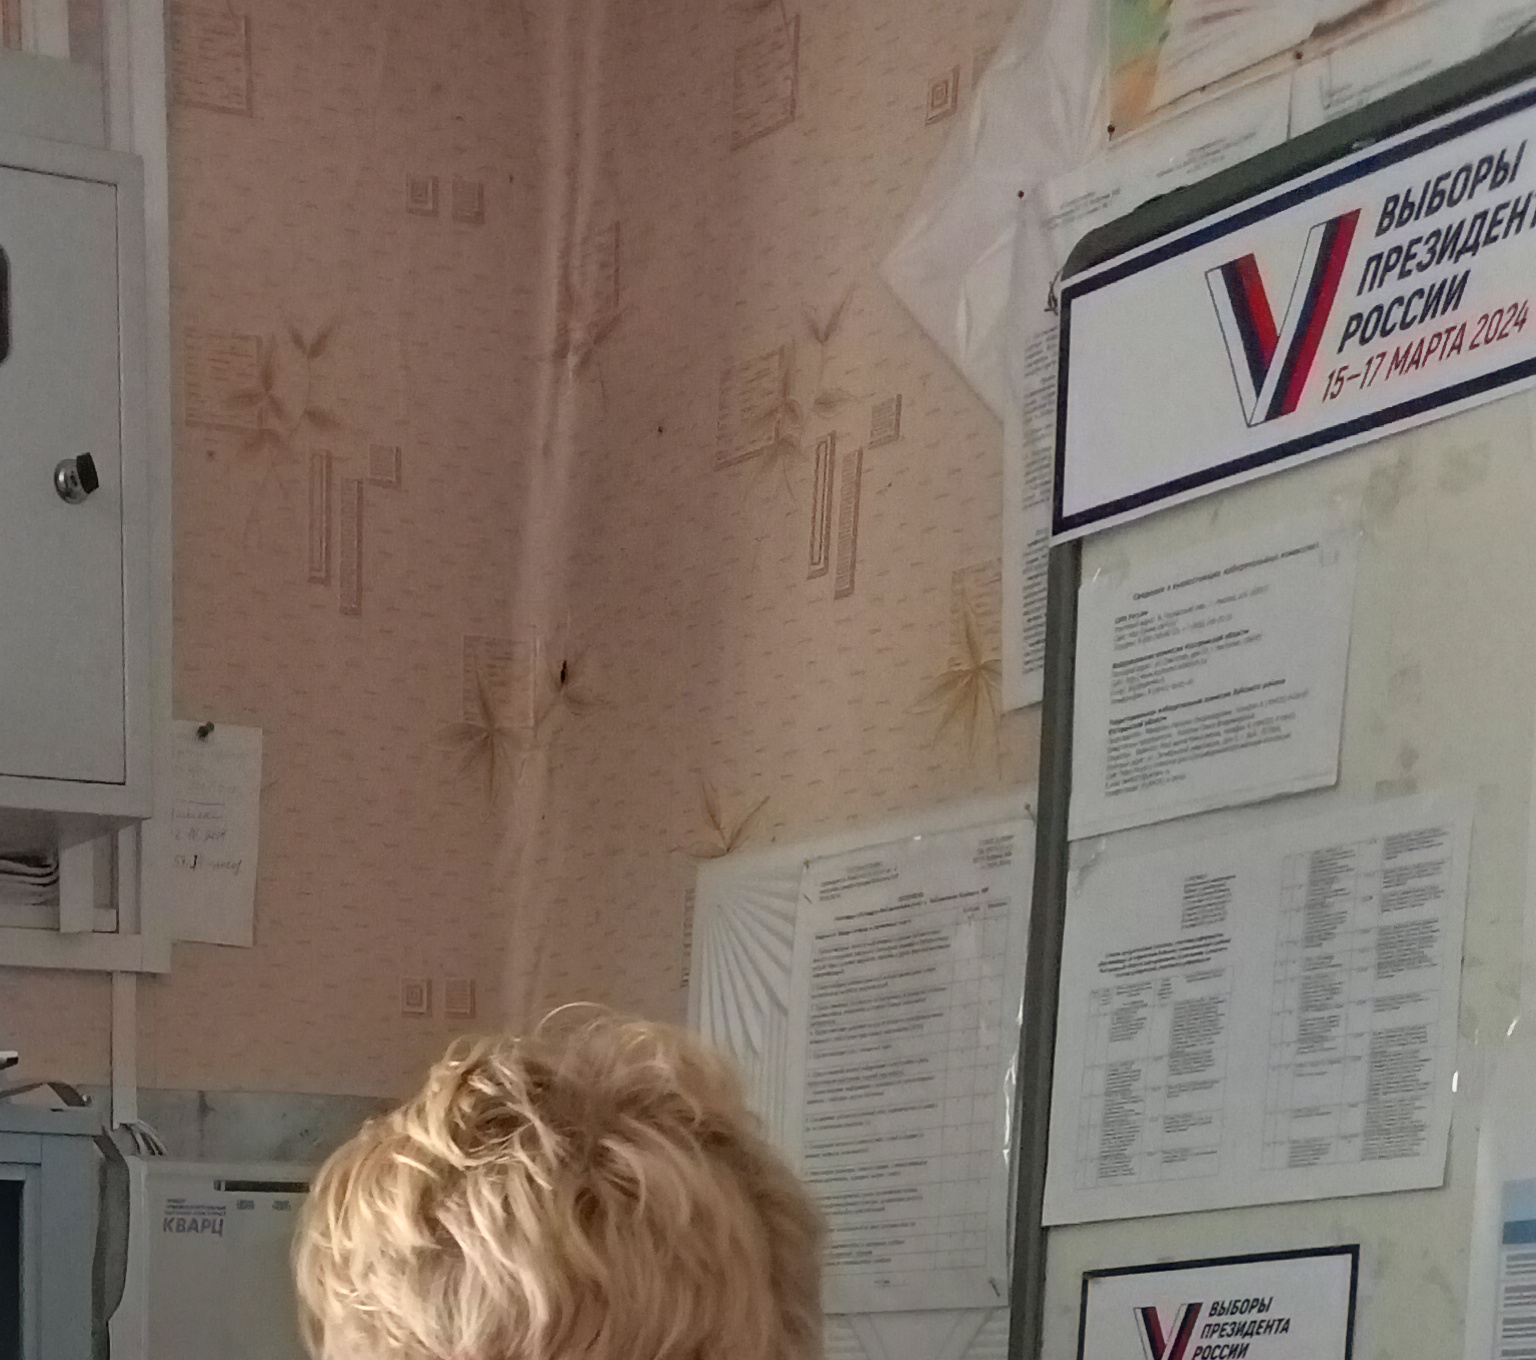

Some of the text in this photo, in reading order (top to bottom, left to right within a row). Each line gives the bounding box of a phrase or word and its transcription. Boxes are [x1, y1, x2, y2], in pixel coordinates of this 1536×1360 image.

[1375, 139, 1528, 238] ВЫБОРЫ
[1337, 269, 1471, 354] РОССИИ
[1385, 321, 1467, 381] МАРТА
[1468, 299, 1529, 351] 2024
[163, 1217, 224, 1236] КВАРЦ
[1208, 1297, 1273, 1316] ВЫБОРЫ
[1200, 1318, 1291, 1339] ПРЕЗИДЕНТА
[1191, 1343, 1249, 1360] РОССИИ
